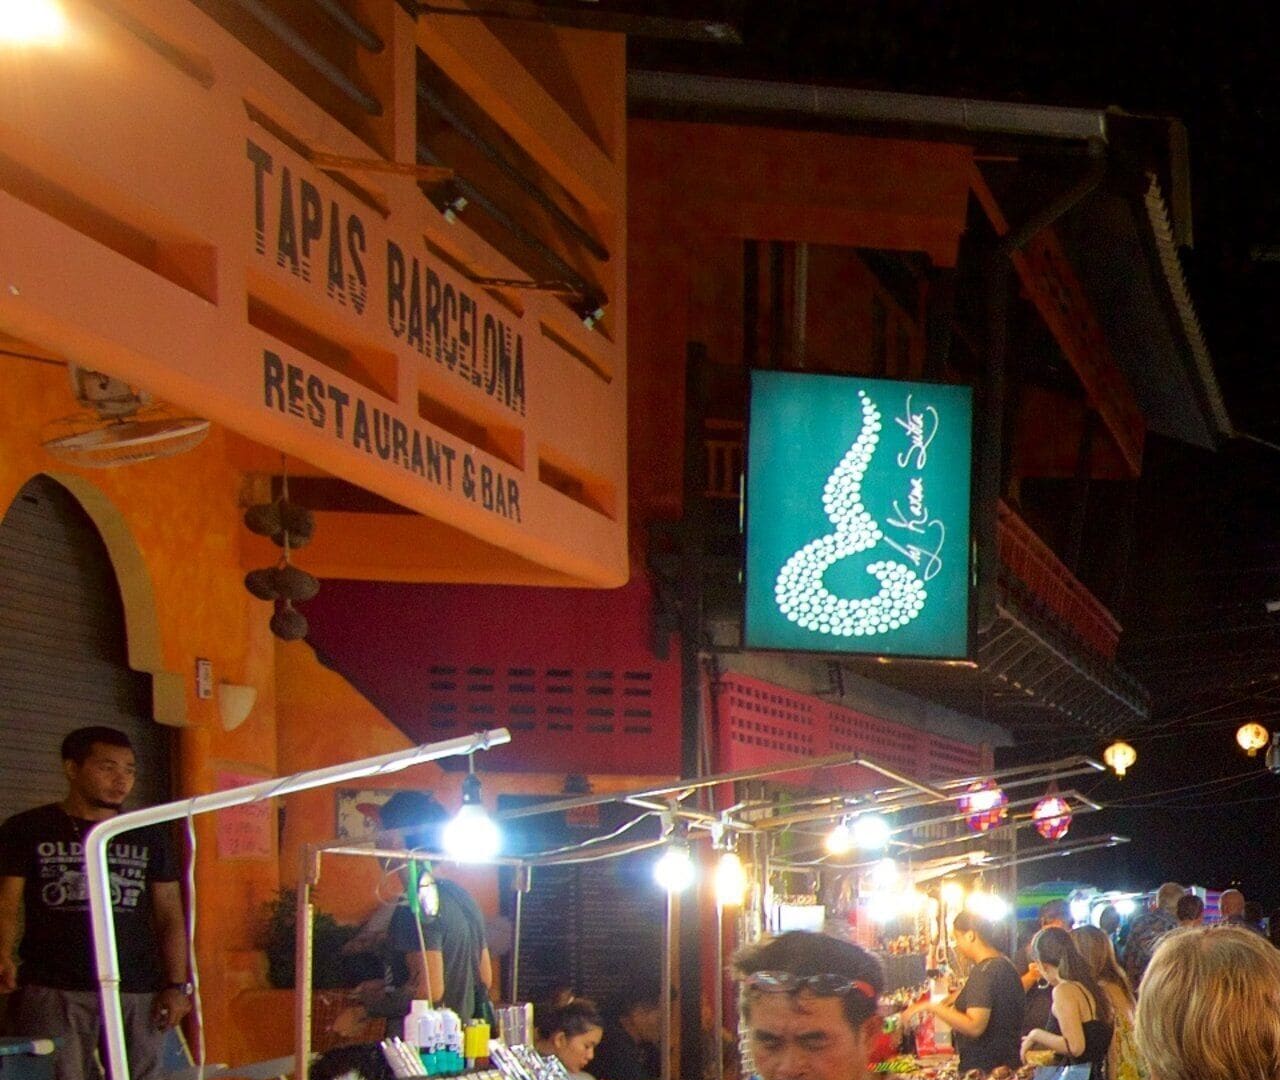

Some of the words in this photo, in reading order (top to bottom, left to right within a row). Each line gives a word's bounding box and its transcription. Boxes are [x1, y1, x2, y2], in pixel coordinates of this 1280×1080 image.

[246, 138, 368, 316] TAPAS
[387, 238, 527, 417] BARCELONA
[263, 349, 457, 493] RESTAURANT
[462, 453, 477, 504] &
[480, 463, 523, 524] BAR
[38, 842, 81, 857] OLD
